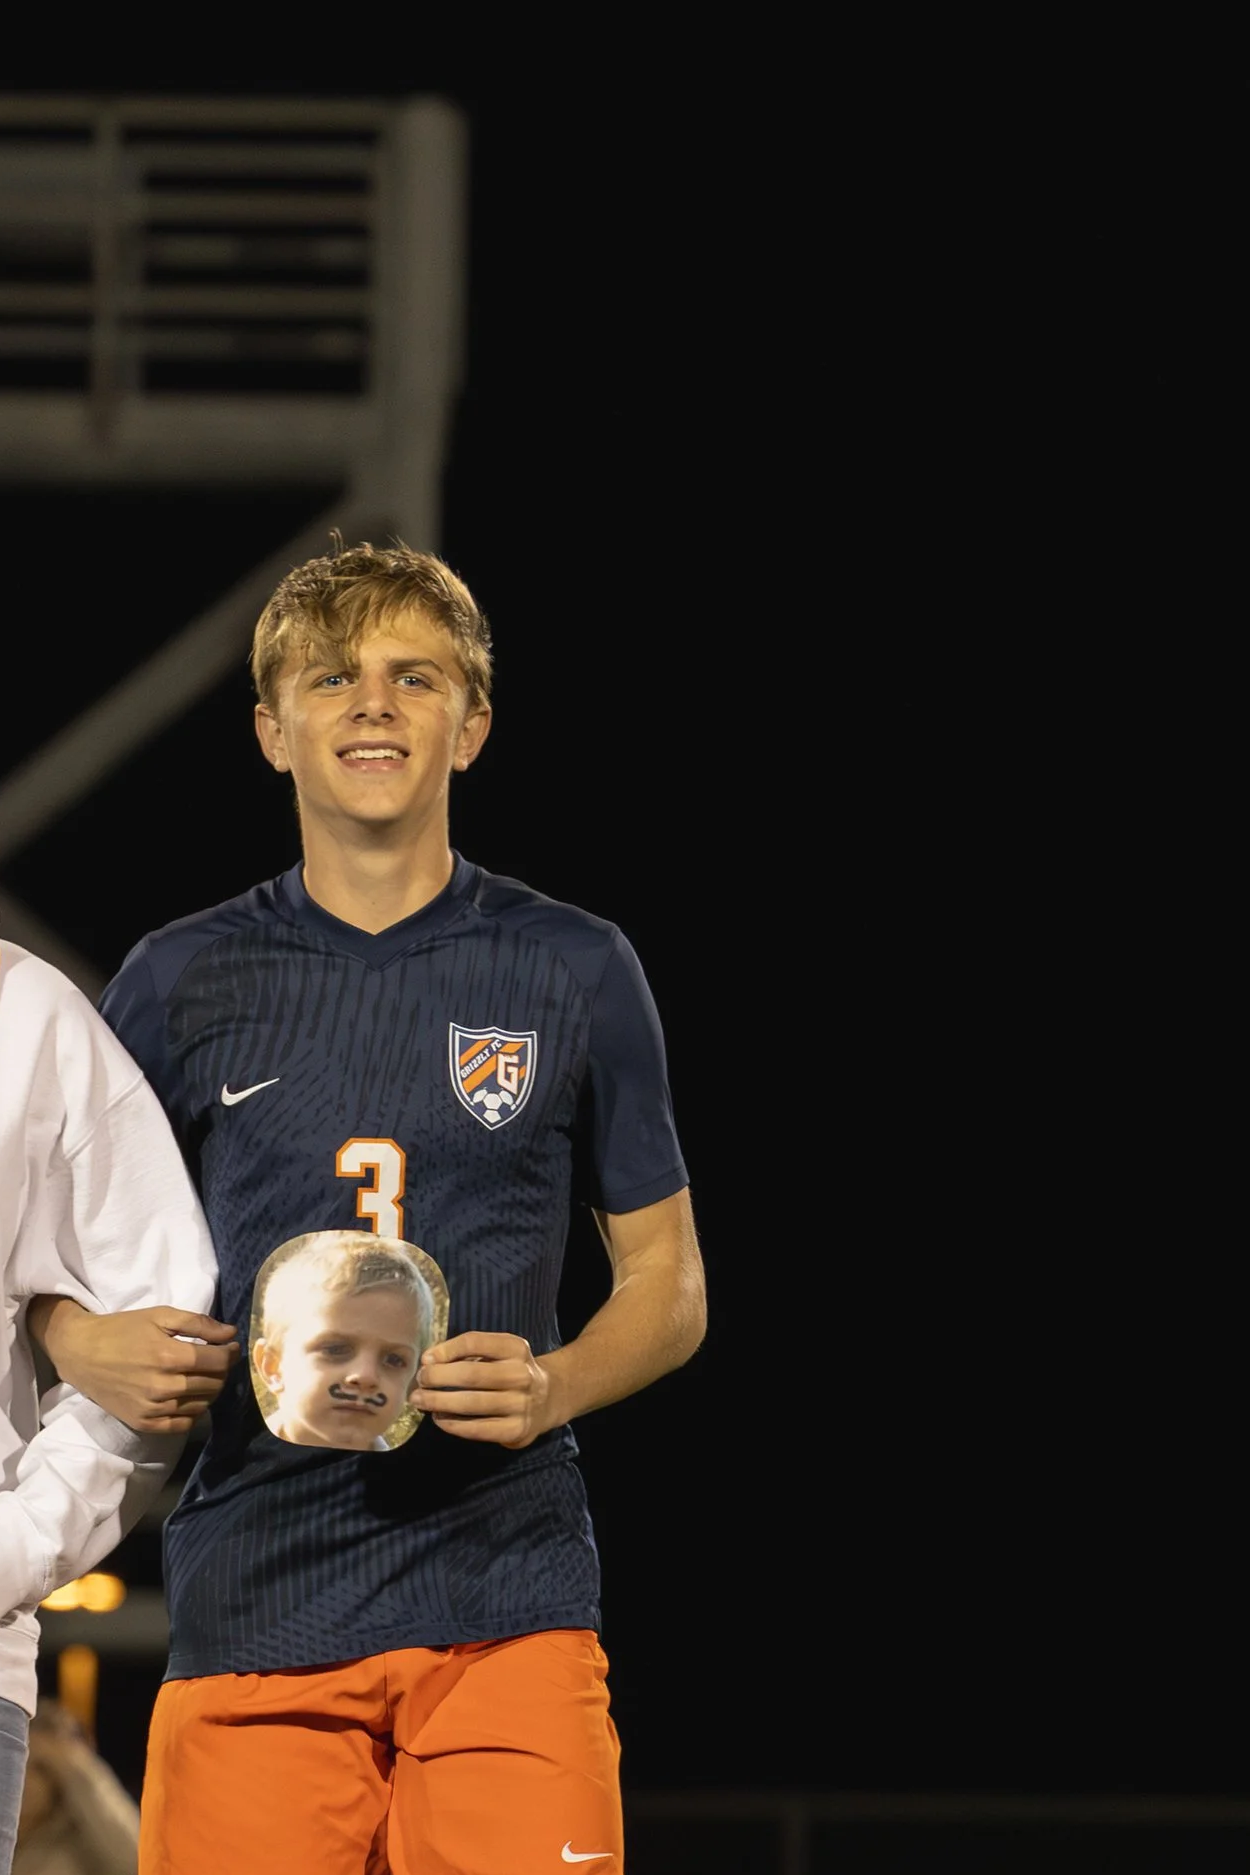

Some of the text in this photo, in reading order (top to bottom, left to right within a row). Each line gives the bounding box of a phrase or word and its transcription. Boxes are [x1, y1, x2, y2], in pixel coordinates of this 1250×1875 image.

[460, 1039, 502, 1079] GRIZZLY FC
[496, 1052, 519, 1096] G
[335, 1137, 406, 1239] 3
